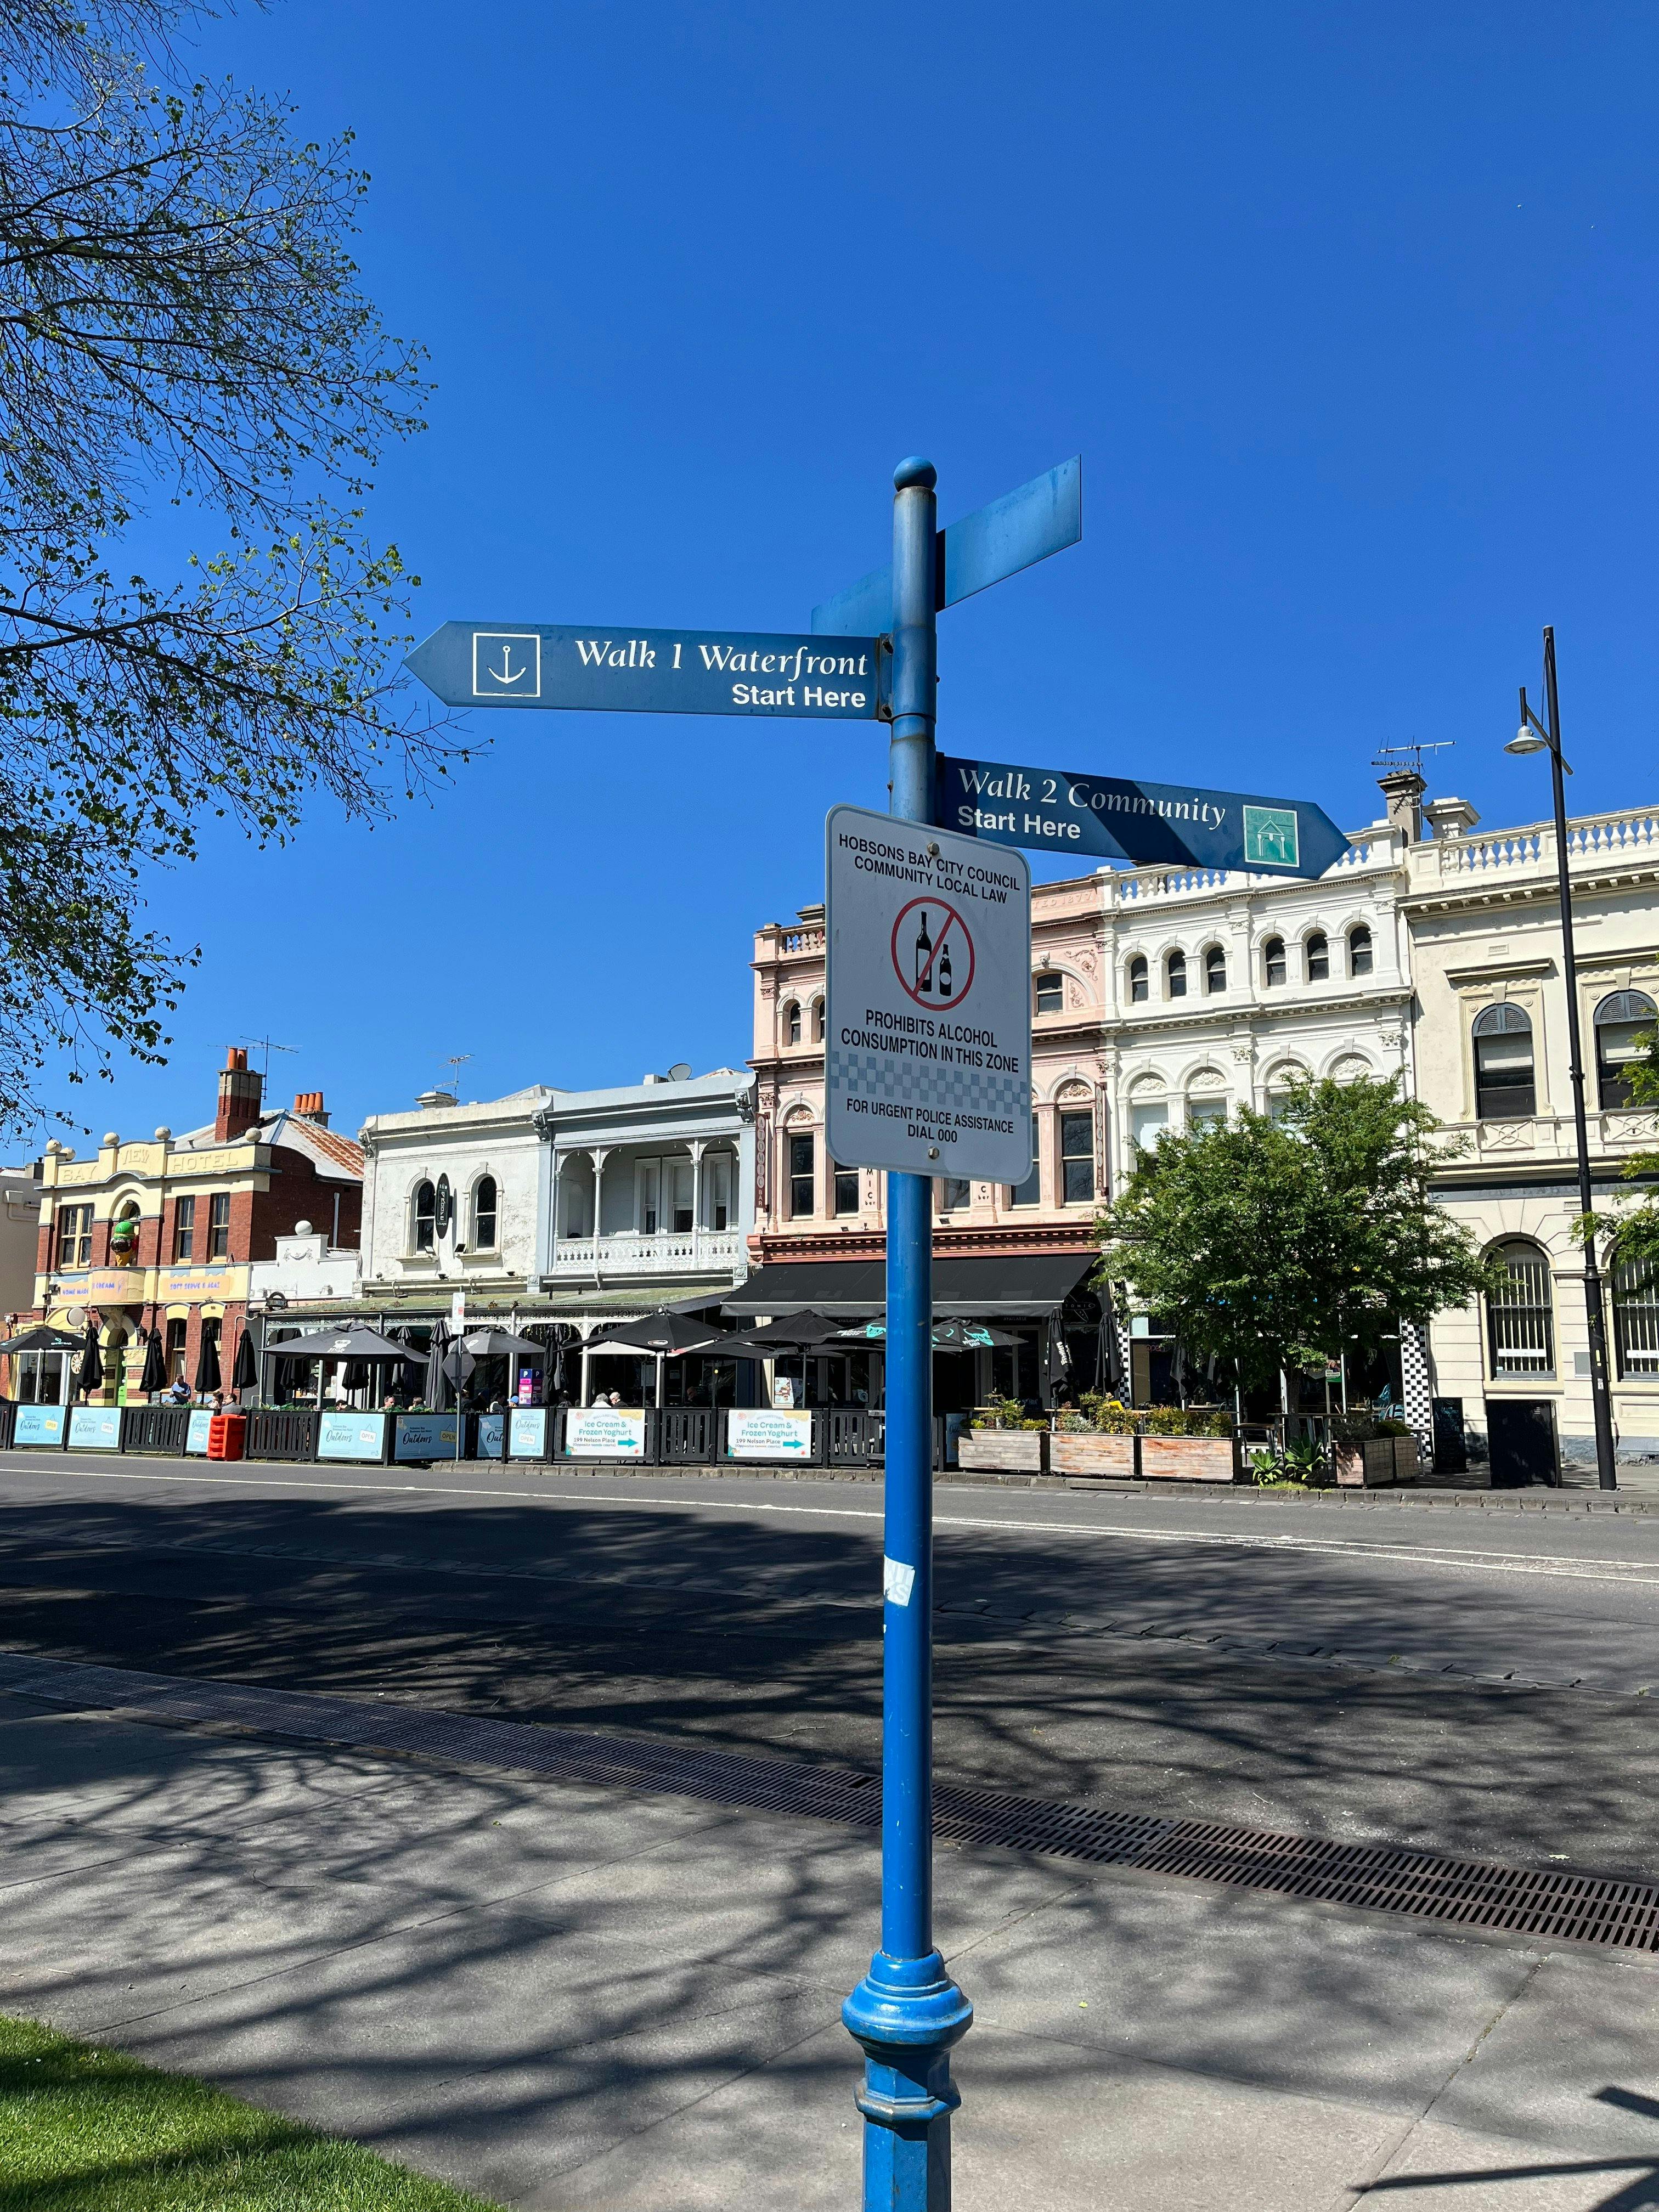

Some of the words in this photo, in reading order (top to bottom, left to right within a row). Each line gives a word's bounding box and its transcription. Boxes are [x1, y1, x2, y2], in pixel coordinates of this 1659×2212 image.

[575, 640, 656, 670] Walk
[672, 644, 681, 669] 1
[699, 645, 868, 682] Waterfront
[732, 684, 795, 706] Start
[804, 687, 866, 707] Here
[958, 769, 1030, 801] Walk
[1041, 779, 1057, 804] 2
[1068, 783, 1226, 829] Community
[958, 805, 1015, 831] Start
[1025, 815, 1081, 839] Here
[839, 833, 904, 861] HOBSONS
[909, 850, 932, 867] BAY
[936, 857, 964, 875] CITY
[967, 863, 1020, 890] COUNCIL
[855, 855, 932, 885] COMMUNITY
[936, 873, 979, 896] LOCAL
[982, 885, 1008, 904] LAW
[1063, 892, 1091, 905] 1877
[866, 1009, 934, 1037] PROHIBITS
[939, 1024, 998, 1048] ALCOHOL
[841, 1028, 938, 1059] CONSUMPTION
[941, 1046, 952, 1062] IN
[956, 1049, 983, 1068] THIS
[986, 1053, 1019, 1073] ZONE
[847, 1098, 868, 1113] FOR
[871, 1102, 913, 1120] URGENT
[916, 1108, 951, 1125] POLICE
[955, 1114, 1013, 1134] ASSISTANCE
[908, 1124, 934, 1139] DIAL
[938, 1127, 957, 1143] 000
[63, 1166, 97, 1181] BAY
[122, 1149, 150, 1165] VIEW
[172, 1152, 238, 1171] HOTEL
[326, 1430, 353, 1442] Outdoors
[403, 1432, 432, 1445] Outdoors
[487, 1431, 504, 1443] Out
